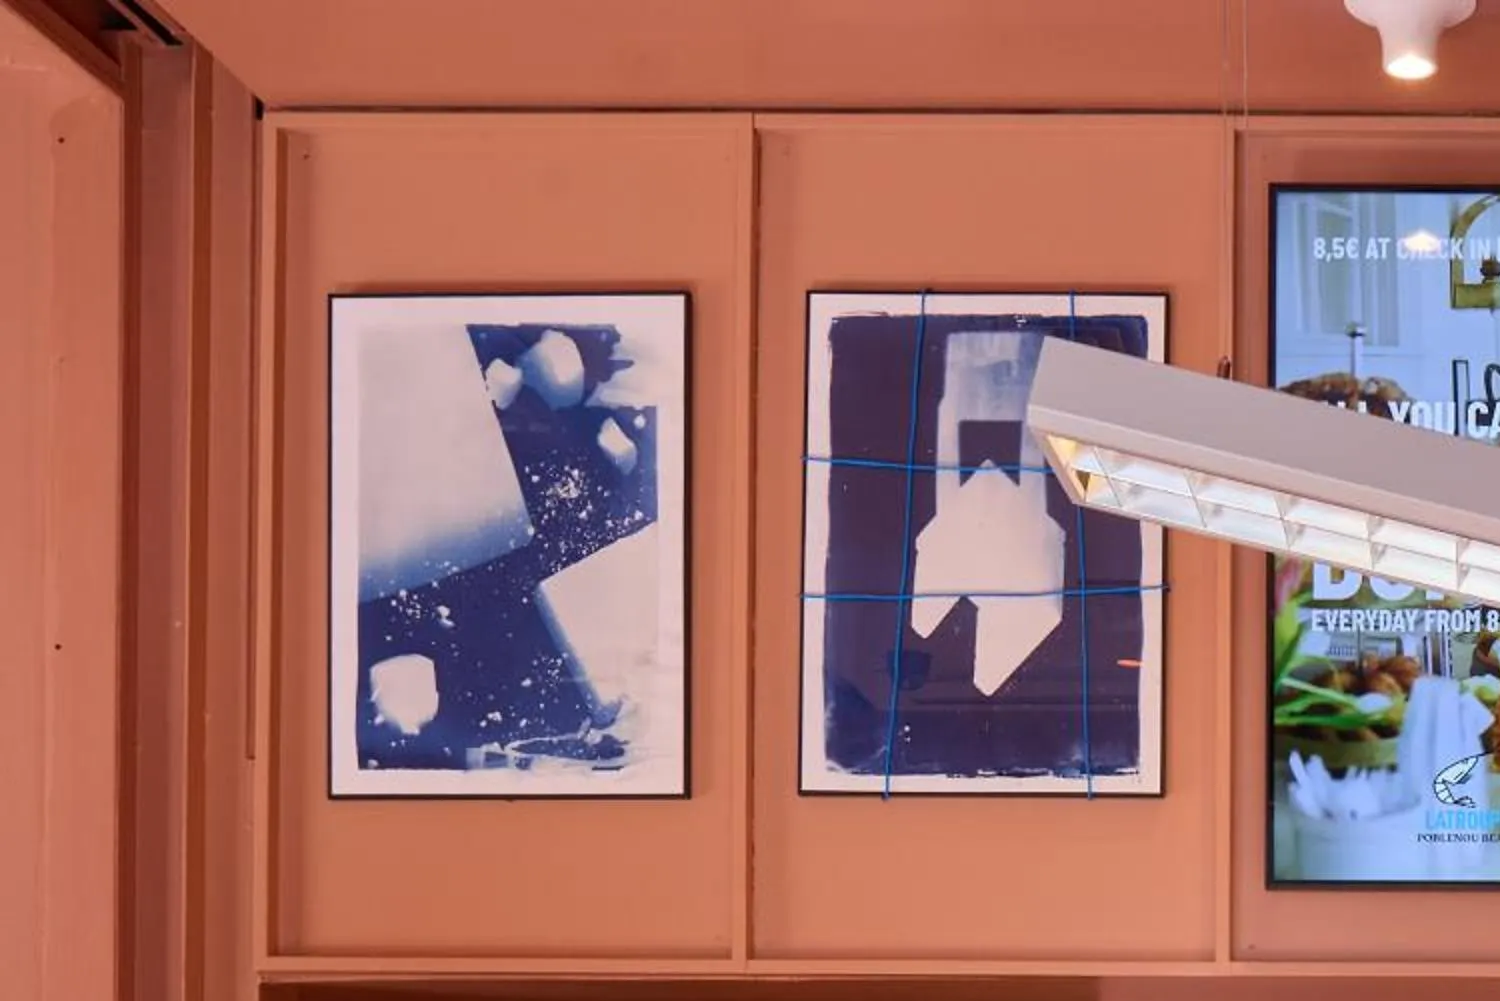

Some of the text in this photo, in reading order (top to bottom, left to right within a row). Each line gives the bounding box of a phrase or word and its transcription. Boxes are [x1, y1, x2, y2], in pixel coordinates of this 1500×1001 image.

[1313, 237, 1359, 262] 8,5€
[1365, 237, 1391, 259] AT
[1469, 237, 1491, 260] IN
[1312, 609, 1419, 633] EVERYDAY
[1425, 610, 1481, 632] FROM
[1417, 833, 1479, 843] POBLENOU
